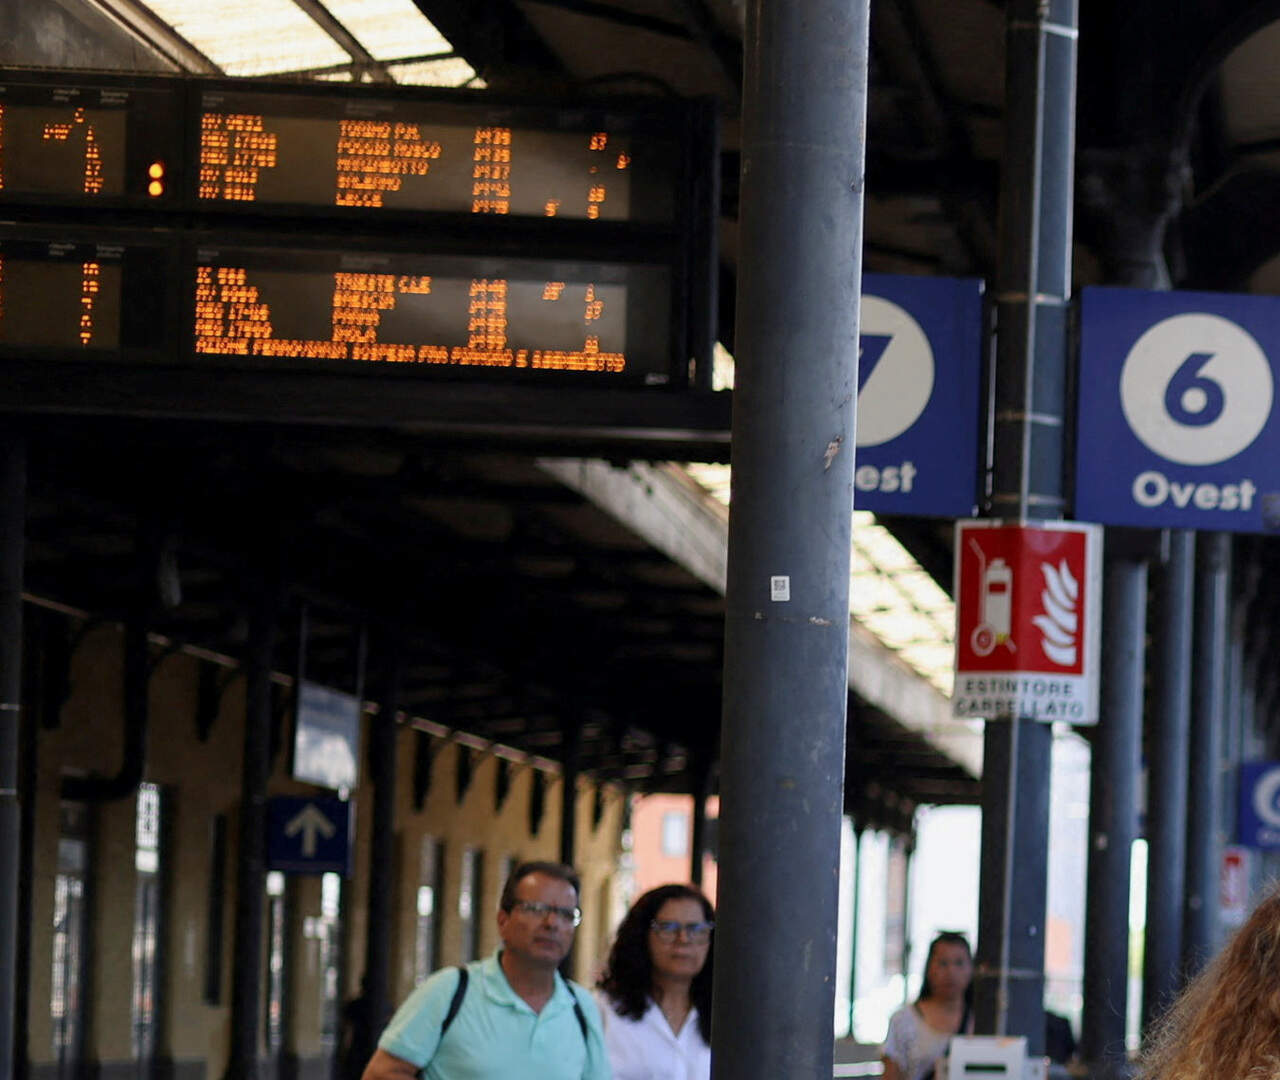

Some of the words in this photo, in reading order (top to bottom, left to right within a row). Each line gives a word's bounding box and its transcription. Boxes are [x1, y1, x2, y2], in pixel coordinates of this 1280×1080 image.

[857, 333, 895, 396] 7
[1164, 352, 1225, 428] 6
[855, 461, 916, 493] est
[1132, 470, 1257, 511] Ovest
[965, 680, 1074, 695] ESTINTORE
